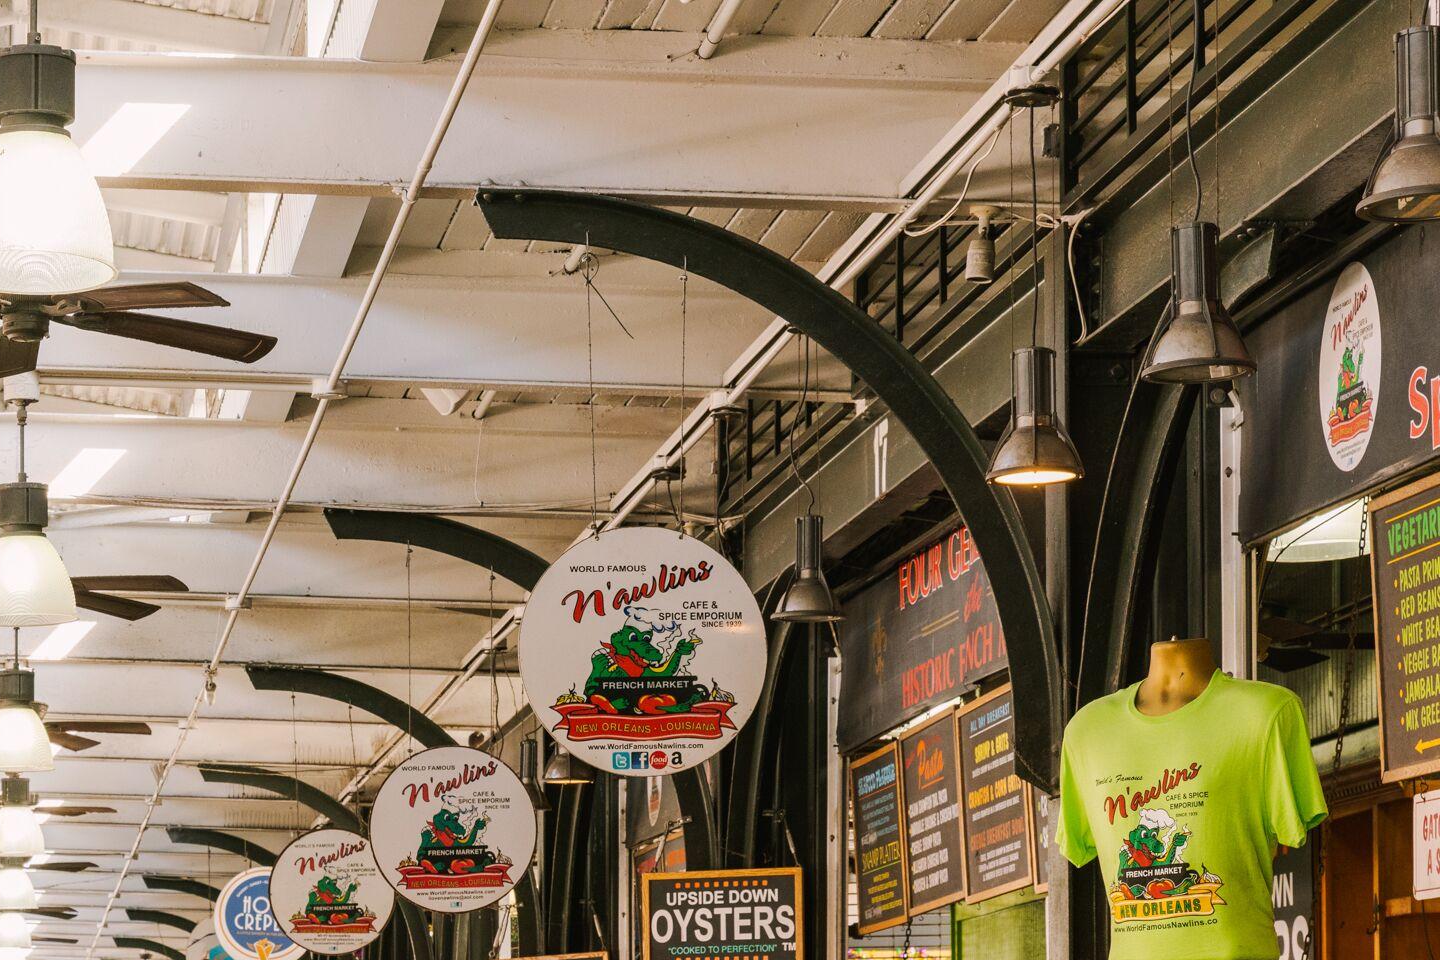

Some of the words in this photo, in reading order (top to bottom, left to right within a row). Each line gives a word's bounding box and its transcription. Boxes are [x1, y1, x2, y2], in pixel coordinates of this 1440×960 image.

[569, 565, 605, 573] WORLD
[606, 564, 647, 573] FAMOUS
[899, 543, 943, 611] FOUR
[1400, 565, 1420, 592] PASTA
[561, 560, 714, 624] N'awlins
[658, 612, 688, 621] SPICE
[689, 611, 743, 621] EMPORIUM
[682, 601, 708, 610] CAFE
[711, 601, 719, 609] &
[1401, 595, 1415, 620] RED
[1402, 621, 1423, 647] WHITE
[1403, 647, 1430, 676] VEGGIE
[602, 681, 644, 690] FRENCH
[646, 680, 690, 689] MARKET
[901, 647, 955, 709] HISTORIC
[986, 702, 1010, 726] BREAKFAST
[1406, 708, 1419, 732] MIX
[575, 723, 598, 734] NEW
[602, 721, 652, 734] ORLEANS
[660, 721, 717, 732] LOUISIANA
[587, 743, 704, 751] www.WorldFamousNawlins.com
[917, 740, 944, 782] Pasta
[402, 761, 498, 808] N'awlins
[1115, 774, 1143, 784] Famous
[1104, 762, 1202, 825] N'awlins
[1170, 801, 1204, 810] EMPORIUM
[1188, 791, 1209, 799] SPICE
[295, 840, 366, 875] N'awlins
[1427, 849, 1433, 876] A
[428, 879, 459, 888] ORLEANS
[465, 878, 501, 886] LOUISIANA
[1126, 869, 1153, 878] FRENCH
[1154, 867, 1183, 876] MARKET
[666, 890, 725, 906] UPSIDE
[728, 888, 779, 904] DOWN
[1120, 905, 1137, 918] NEW
[1143, 898, 1202, 917] ORLEANS
[651, 904, 795, 944] OYSTERS
[708, 945, 720, 954] TO
